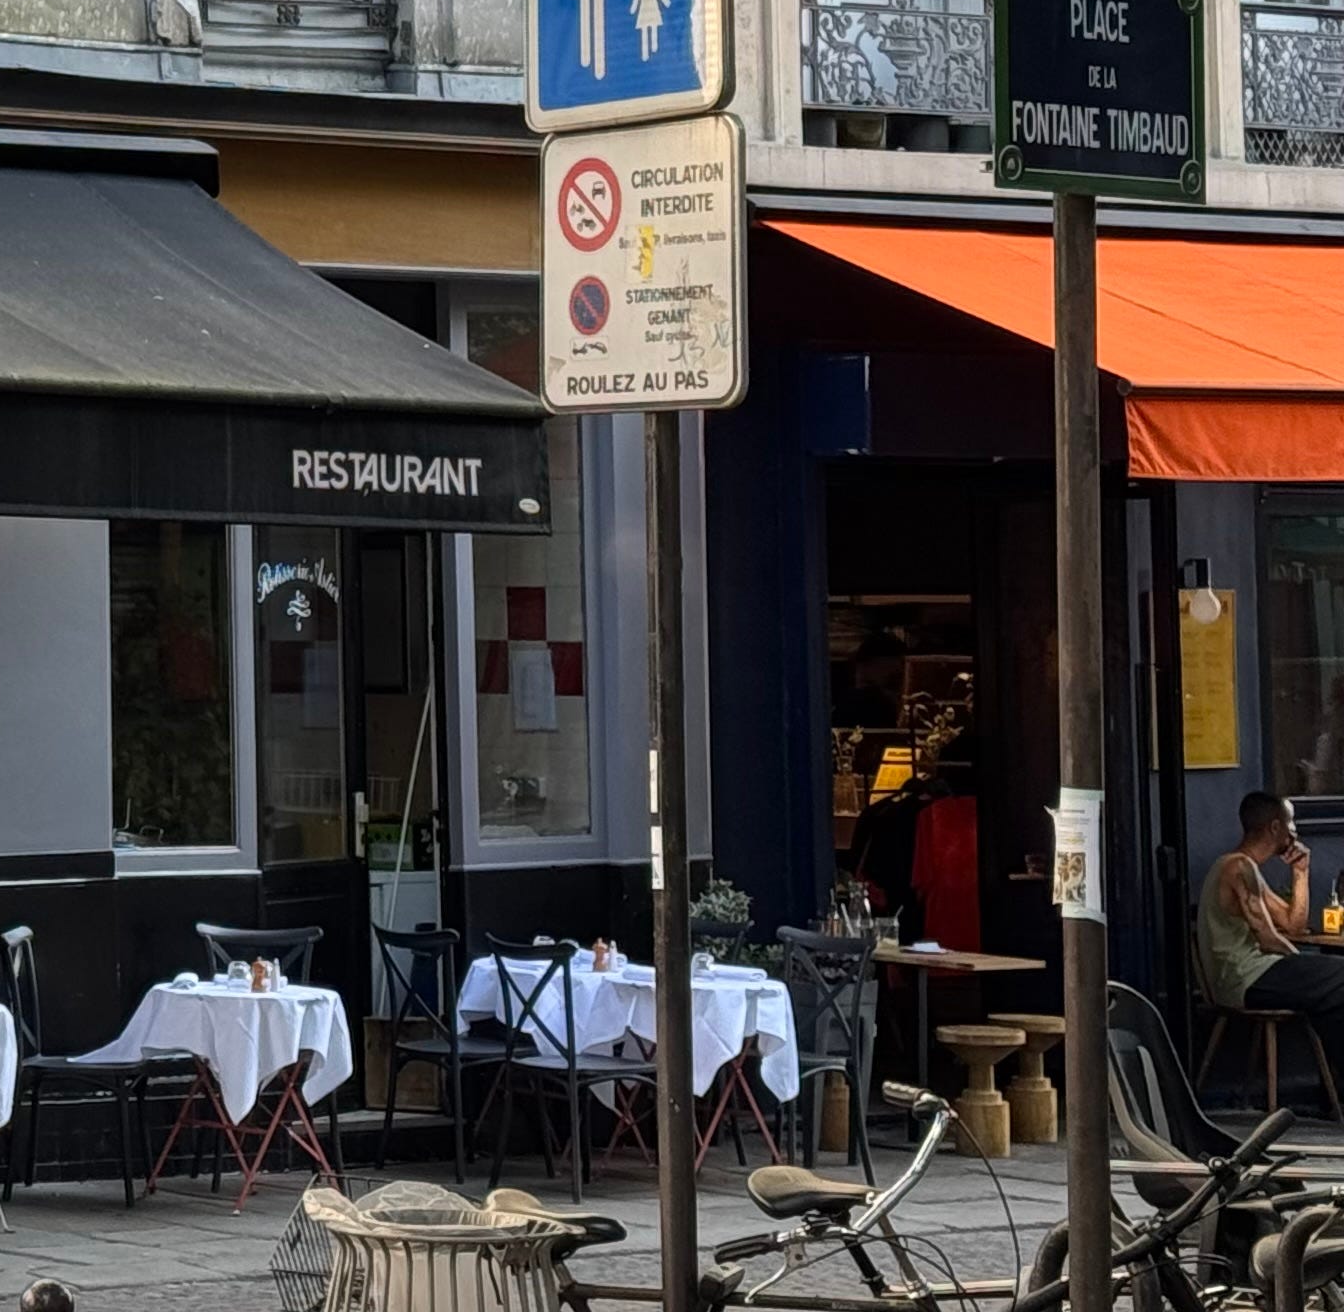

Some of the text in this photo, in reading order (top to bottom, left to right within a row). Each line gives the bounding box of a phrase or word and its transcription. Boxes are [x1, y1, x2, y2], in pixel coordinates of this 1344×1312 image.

[1088, 65, 1117, 89] DE LA
[1012, 100, 1189, 156] FONTAINE TIMBAUD
[631, 162, 724, 189] CIRCULATION
[641, 193, 714, 218] INTERDITE
[625, 284, 714, 305] STATIONNEMENT
[567, 370, 709, 395] ROULEZ AU PAS
[292, 449, 483, 497] RESTAURANT
